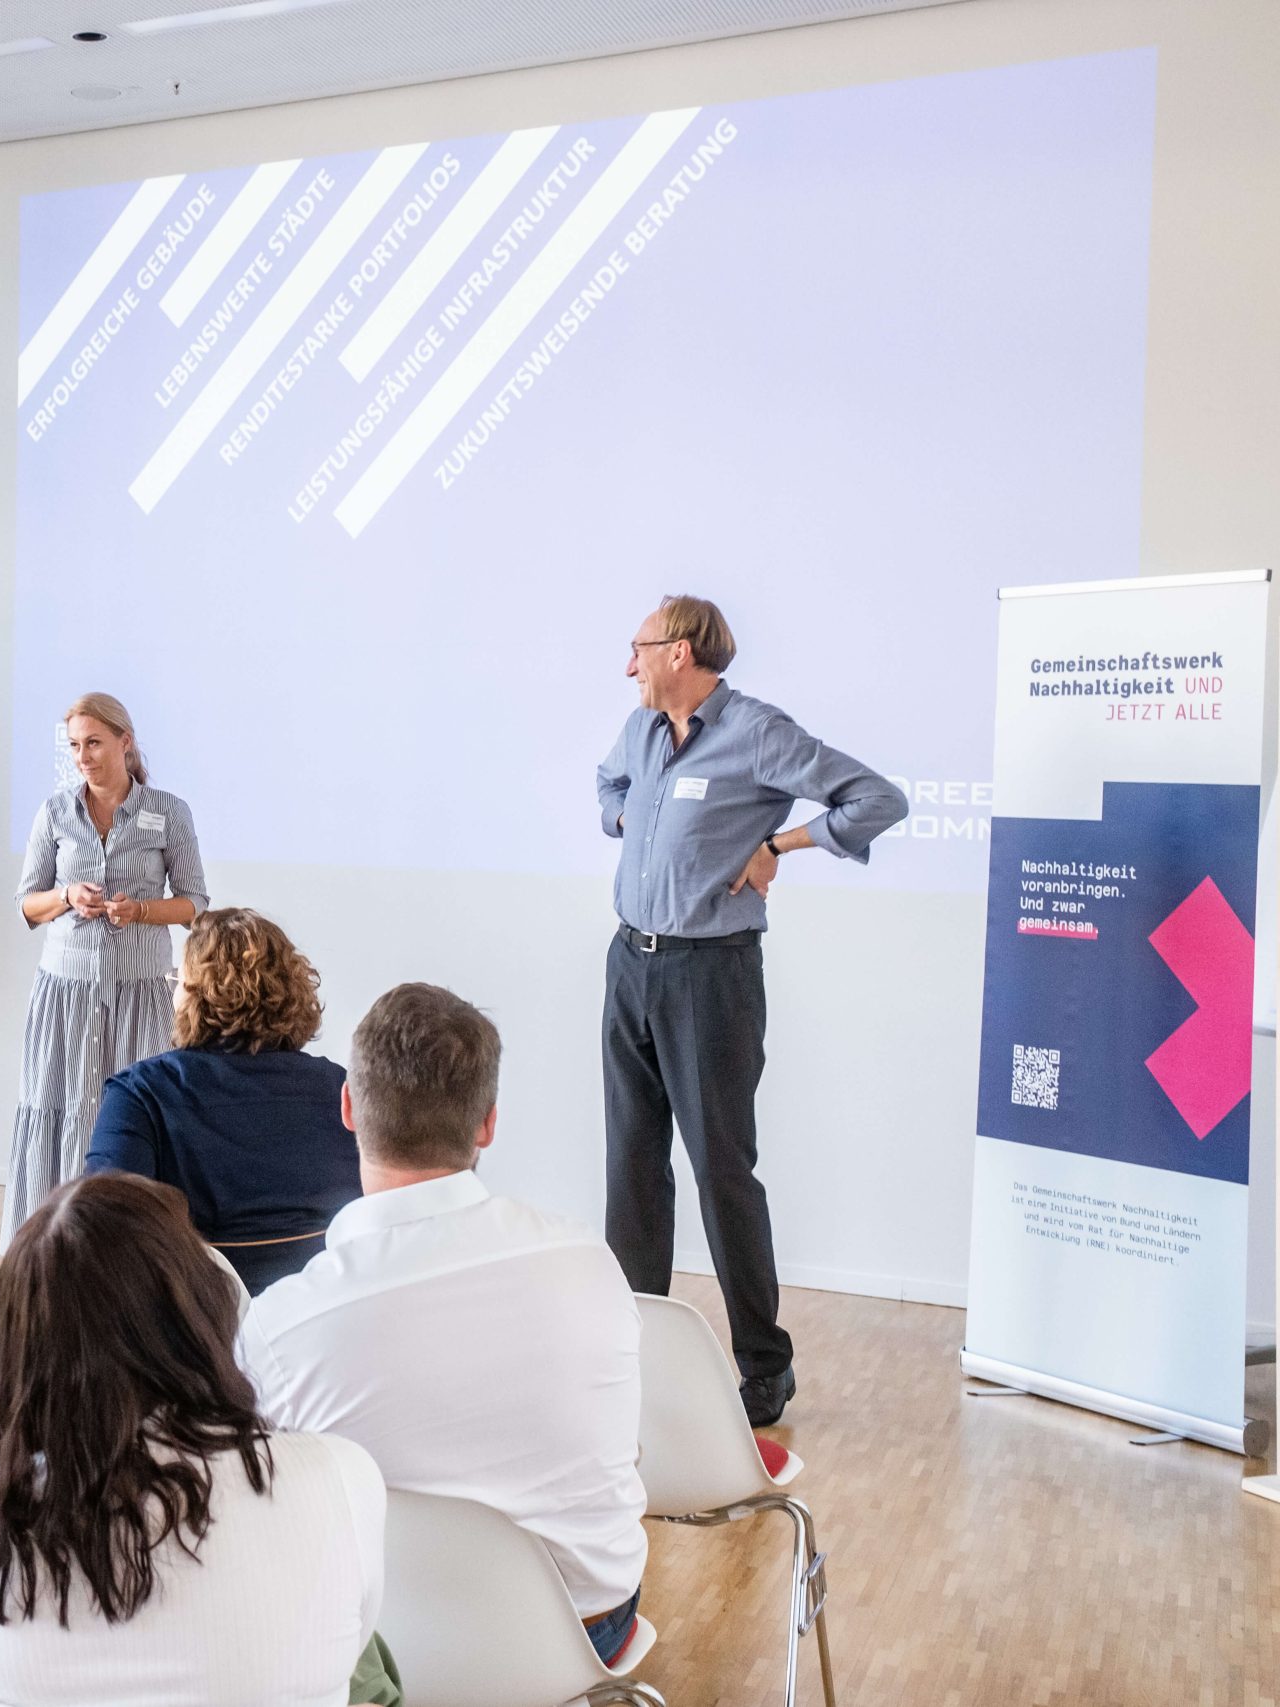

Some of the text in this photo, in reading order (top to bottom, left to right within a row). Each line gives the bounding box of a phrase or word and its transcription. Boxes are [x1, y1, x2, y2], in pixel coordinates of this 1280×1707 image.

[154, 168, 336, 408] LEBENSWERTE STÄDTE
[433, 118, 739, 491] ZUKUNFTSWEISENDE BERATUNG
[26, 183, 216, 442] ERFOLGREICHE GEBÄUDE
[219, 153, 461, 466] RENDITESTARKE PORTFOLIOS
[287, 136, 596, 524] LEISTUNGSFÄHIGE INFRASTRUKTUR
[1030, 652, 1223, 673] Gemeinschaftswerk
[1029, 677, 1223, 699] Nachhaltigkeit UND
[1105, 703, 1222, 720] JETZT ALLE
[1021, 860, 1137, 880] Nachhaltigkeit
[1020, 896, 1086, 913] Und zwar
[1021, 880, 1125, 899] voranbringen.
[1019, 916, 1099, 934] gemeinsam.
[1011, 1195, 1201, 1241] ist eine Initiative von Bund und Ländern
[1013, 1182, 1198, 1226] Das Gemeinschaftswerk Nachhaltigkeit
[1024, 1212, 1190, 1254] und wird vom Rat für Nachhaltige
[1026, 1225, 1081, 1246] Entwicklung
[1086, 1239, 1110, 1252] (RNE)
